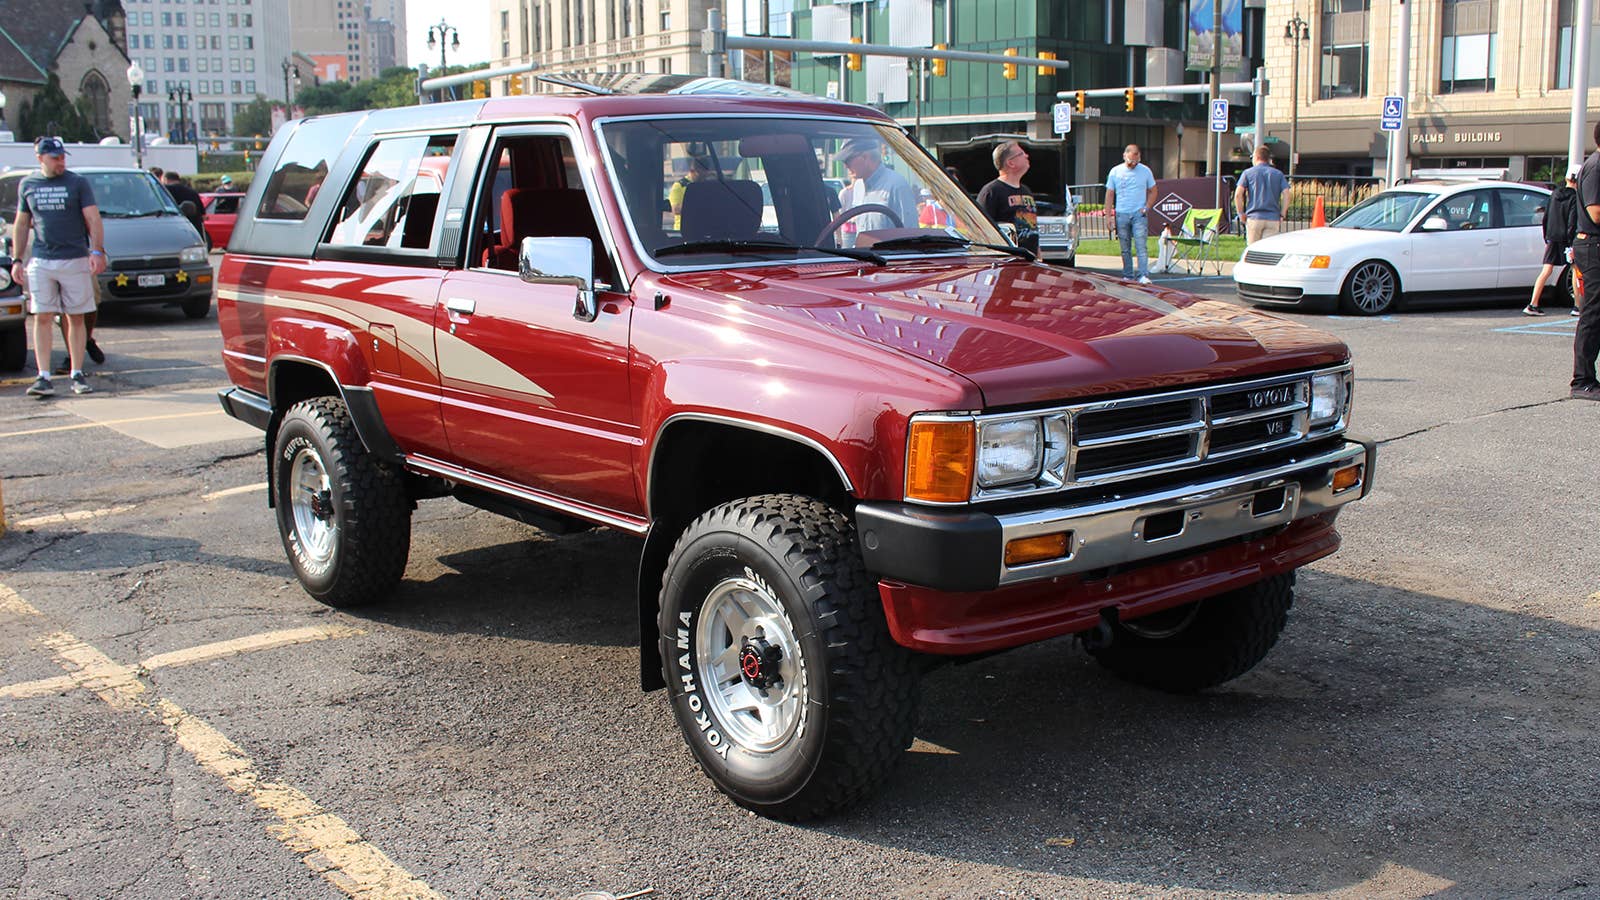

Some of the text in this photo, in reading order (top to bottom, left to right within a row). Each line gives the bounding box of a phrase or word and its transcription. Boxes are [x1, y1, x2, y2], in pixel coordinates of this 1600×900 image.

[1412, 132, 1502, 143] PALMS BUILDING
[1247, 387, 1292, 408] TOYOTA
[283, 436, 306, 461] SUPER
[677, 611, 731, 760] YOKOHAMA
